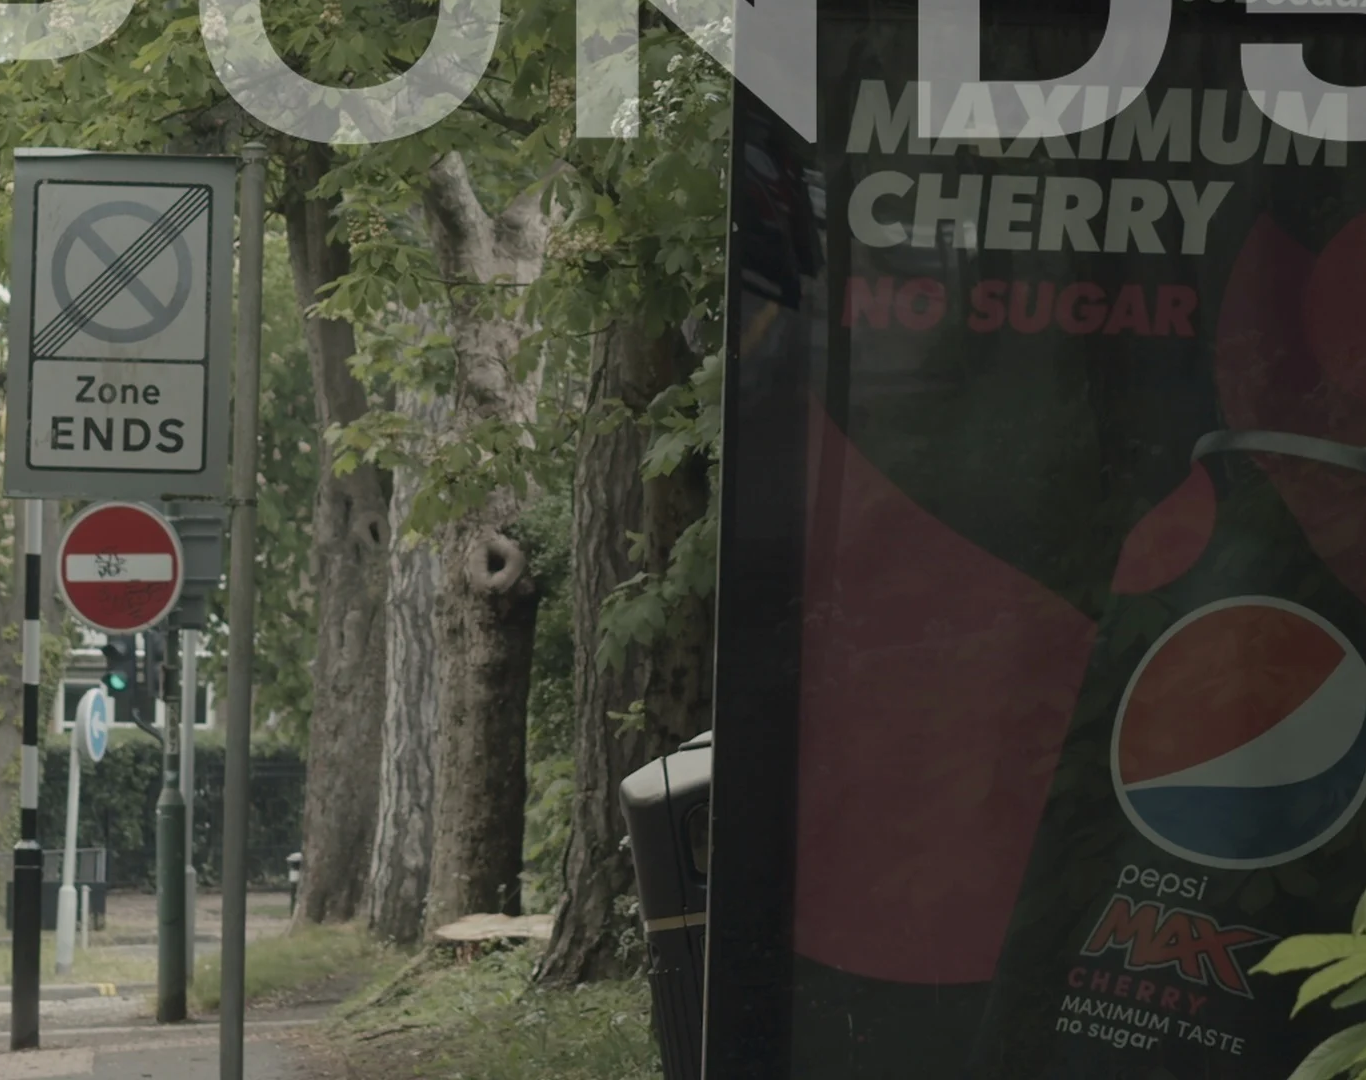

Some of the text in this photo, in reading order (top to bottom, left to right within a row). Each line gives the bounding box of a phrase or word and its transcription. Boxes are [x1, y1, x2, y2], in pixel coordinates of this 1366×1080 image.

[847, 80, 1349, 168] MAXIMUM
[846, 172, 1235, 256] CHERRY
[840, 276, 1198, 339] NO SUGAR
[76, 375, 161, 405] Zone
[50, 416, 185, 453] ENDS
[1117, 864, 1209, 901] pepsi
[1080, 892, 1280, 1000] MAX
[1067, 967, 1208, 1016] CHERRY
[1055, 1016, 1159, 1052] no sugar
[1060, 994, 1246, 1056] MAXIMUM TASTE
